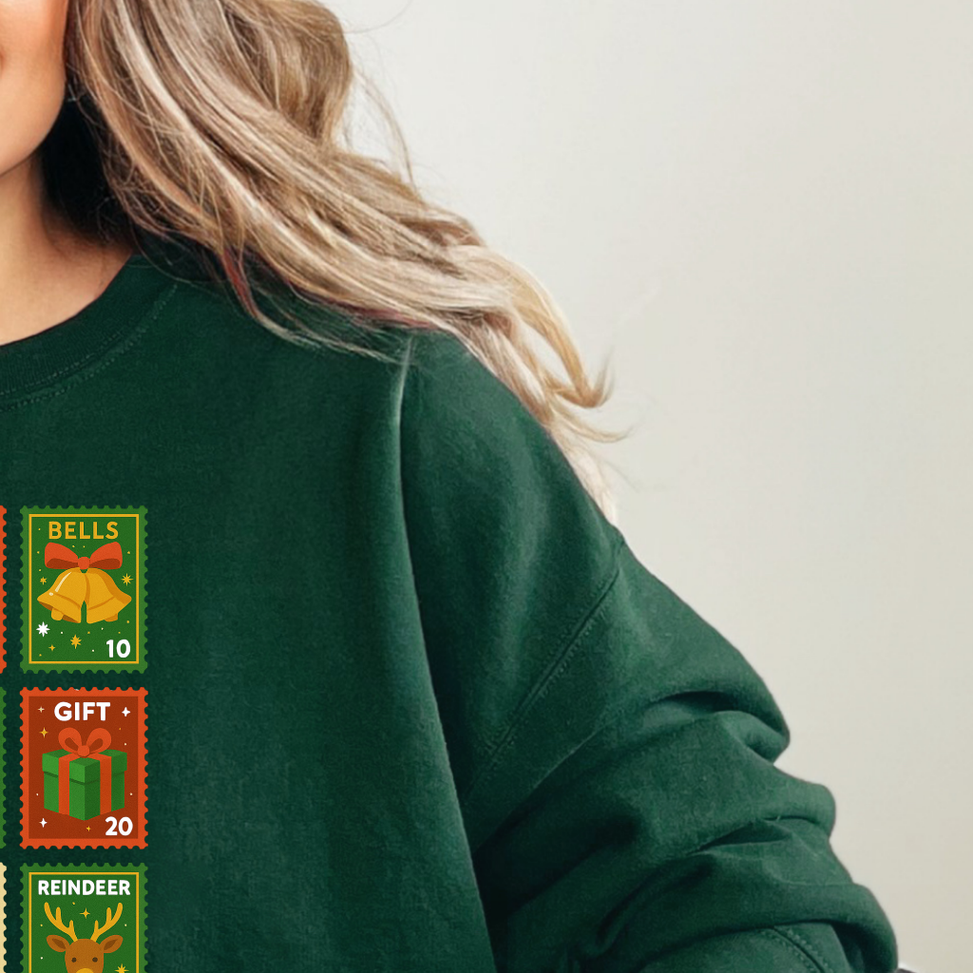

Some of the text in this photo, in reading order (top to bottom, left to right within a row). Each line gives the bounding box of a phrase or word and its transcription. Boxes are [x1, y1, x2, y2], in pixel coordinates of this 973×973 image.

[48, 521, 119, 540] BELLS
[106, 639, 130, 658] 10
[54, 702, 111, 721] GIFT
[105, 816, 133, 836] 20
[38, 880, 130, 895] REINDEER
